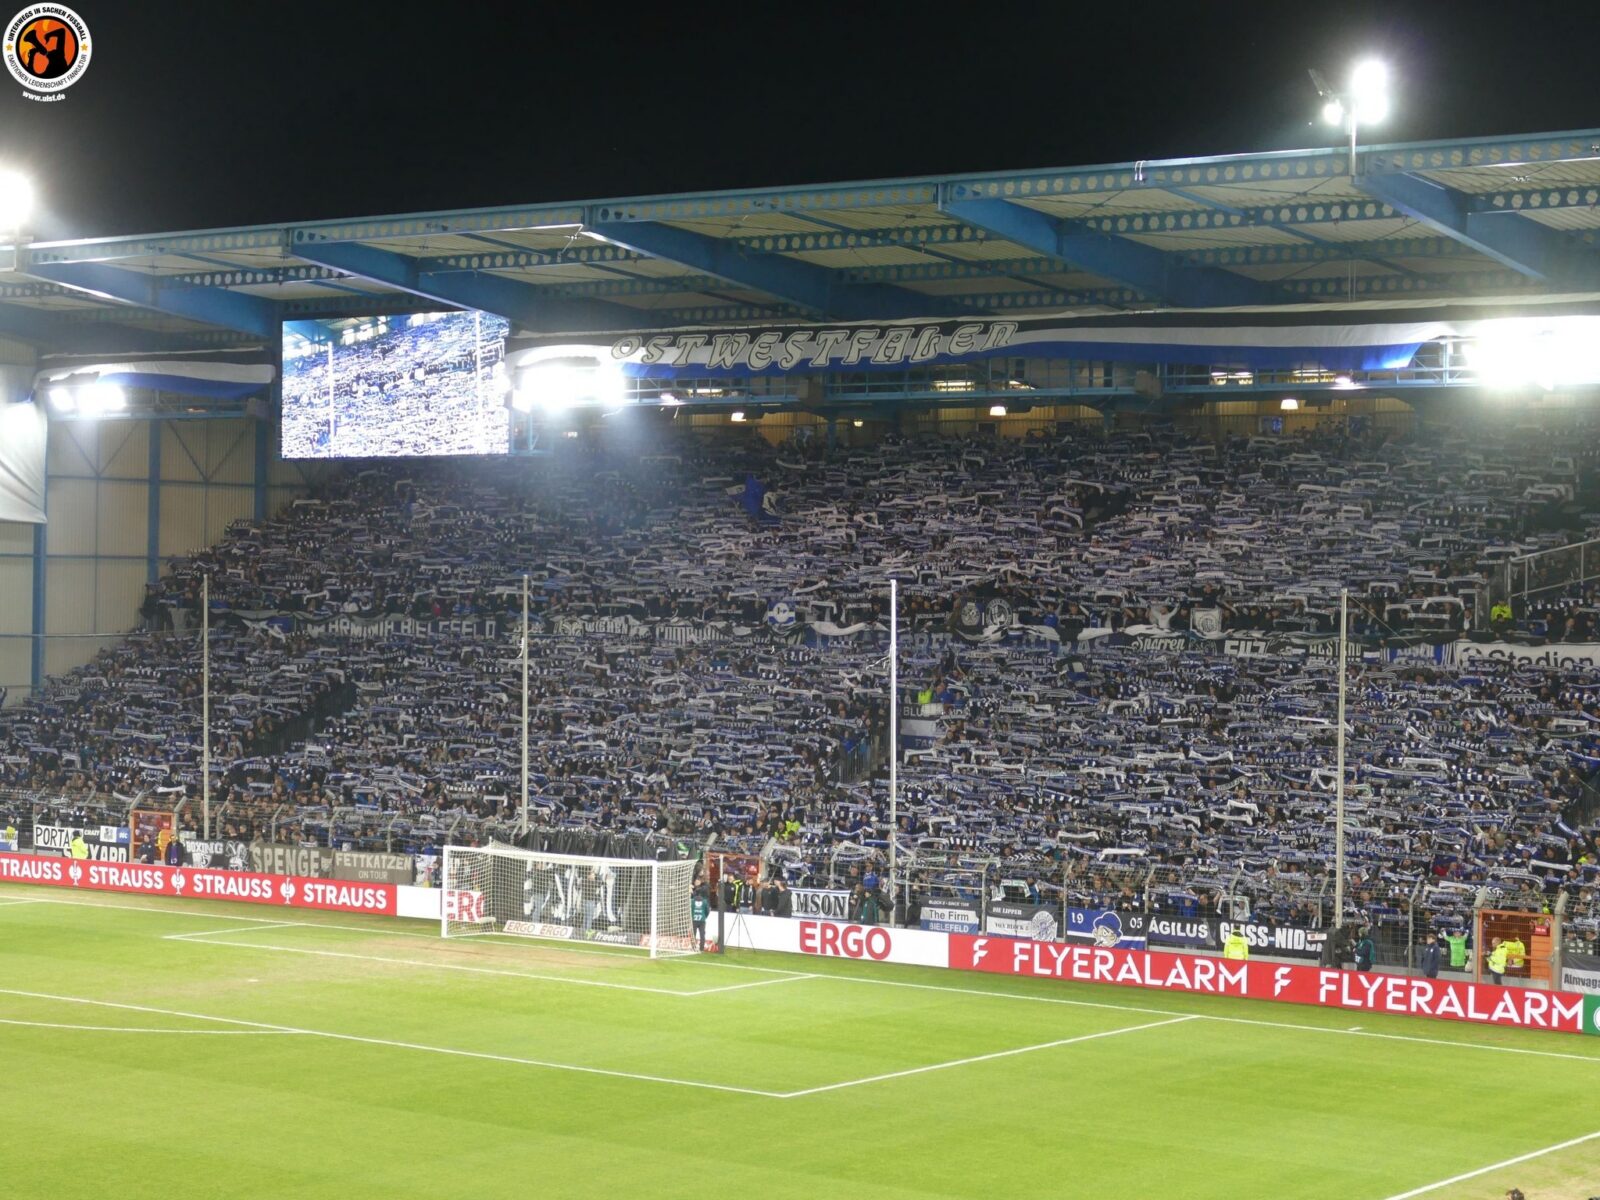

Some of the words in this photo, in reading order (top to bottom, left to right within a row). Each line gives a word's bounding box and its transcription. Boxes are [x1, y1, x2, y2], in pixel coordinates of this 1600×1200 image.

[611, 321, 1020, 372] OSTWESTFALEN
[35, 826, 71, 847] PORTA
[252, 847, 320, 878] SPENGE
[336, 852, 413, 871] FETTKATZEN
[358, 870, 369, 880] ON
[370, 871, 388, 881] TOUR
[89, 865, 164, 889] STRAUSS
[193, 873, 272, 899] STRAUSS
[303, 883, 387, 910] STRAUSS
[929, 909, 946, 920] The
[948, 911, 969, 922] Firm
[1071, 912, 1084, 924] 19
[1129, 917, 1143, 929] 05
[507, 922, 536, 933] ERGO
[539, 925, 569, 937] ERGO
[594, 928, 628, 943] freenet
[929, 922, 969, 933] BIELEFELD
[799, 920, 892, 961] ERGO
[1013, 941, 1248, 995] FLYERALARM
[1319, 970, 1584, 1031] FLYERALARM
